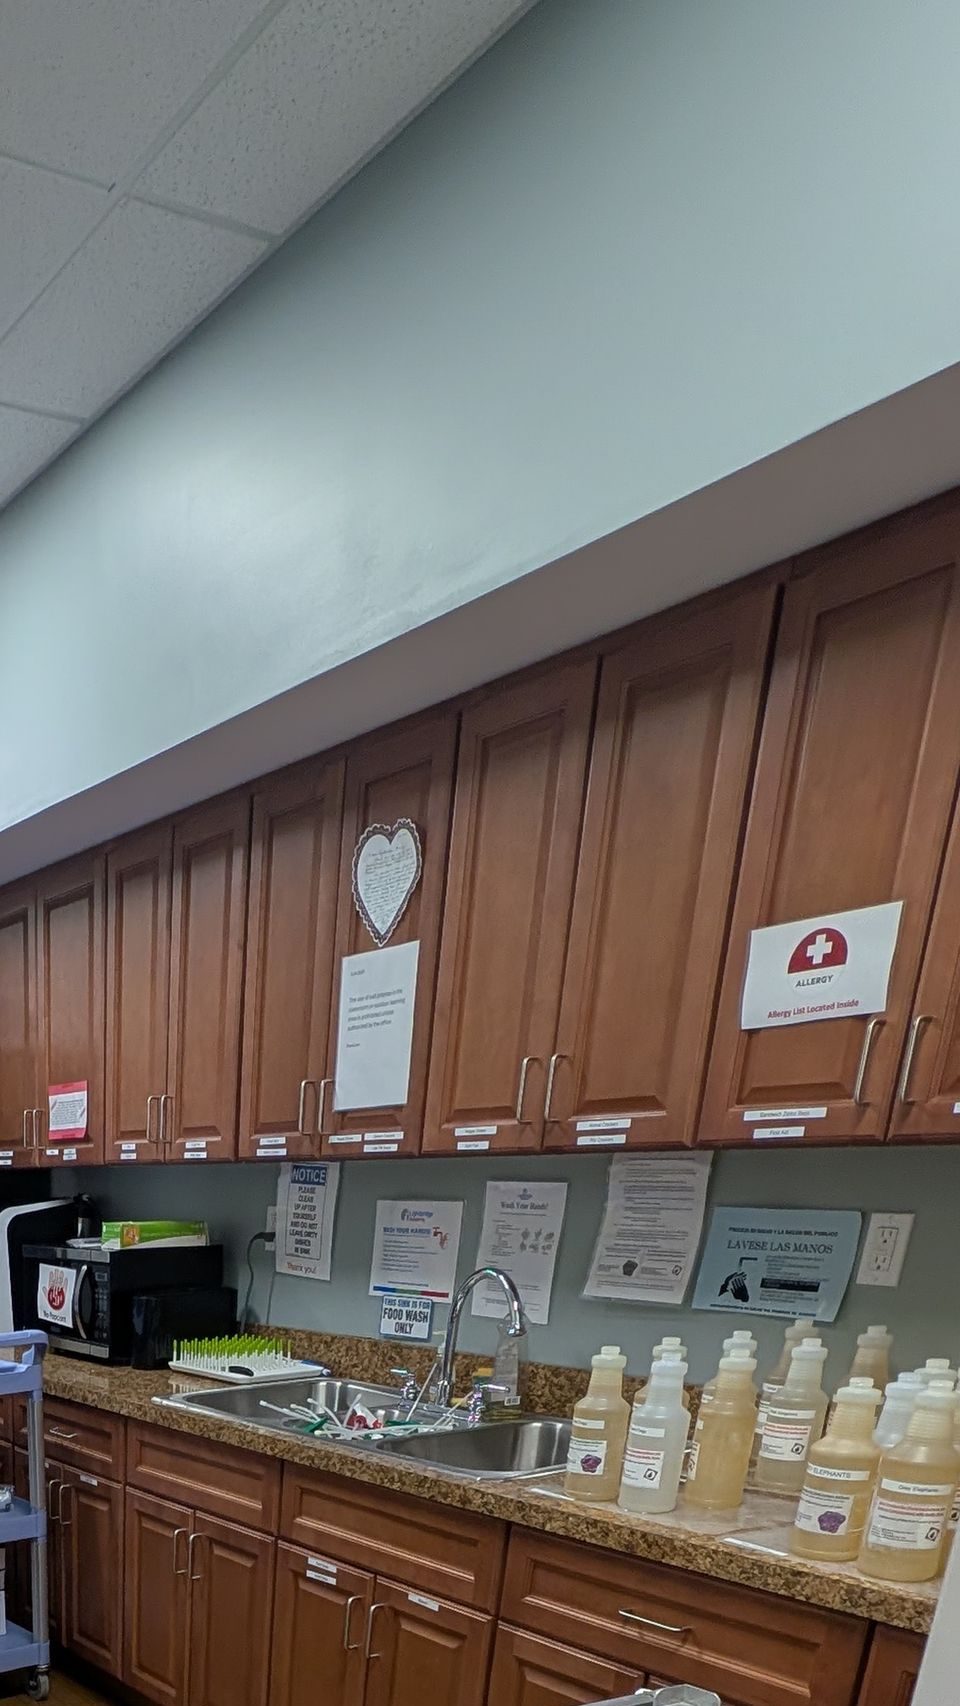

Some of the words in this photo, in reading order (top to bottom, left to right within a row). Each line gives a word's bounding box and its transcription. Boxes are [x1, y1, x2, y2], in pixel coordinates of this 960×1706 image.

[795, 974, 834, 988] ALLERGY
[767, 1008, 792, 1020] Allergy
[793, 1004, 806, 1016] List
[807, 1002, 836, 1014] Located
[836, 998, 860, 1010] Inside
[292, 1167, 326, 1184] NOTICE
[298, 1186, 316, 1195] PLEASE
[294, 1203, 301, 1211] UP
[301, 1204, 316, 1212] AFTER
[293, 1212, 317, 1221] YOURSELF
[290, 1220, 300, 1228] AND
[308, 1222, 318, 1230] NOT
[289, 1229, 303, 1238] LEAVE
[303, 1230, 318, 1239] DIRTY
[727, 1239, 768, 1251] LAVESE
[770, 1241, 791, 1253] LAS
[792, 1242, 833, 1254] MANOS
[385, 1298, 397, 1306] THIS
[397, 1299, 410, 1308] SINK
[411, 1300, 417, 1308] IS
[418, 1301, 430, 1310] FOR
[43, 1310, 49, 1318] No
[49, 1312, 67, 1323] Popcorn
[383, 1308, 403, 1320] FOOD
[405, 1309, 429, 1323] WASH
[394, 1322, 414, 1334] ONLY
[813, 1467, 851, 1479] ELEPHANTS
